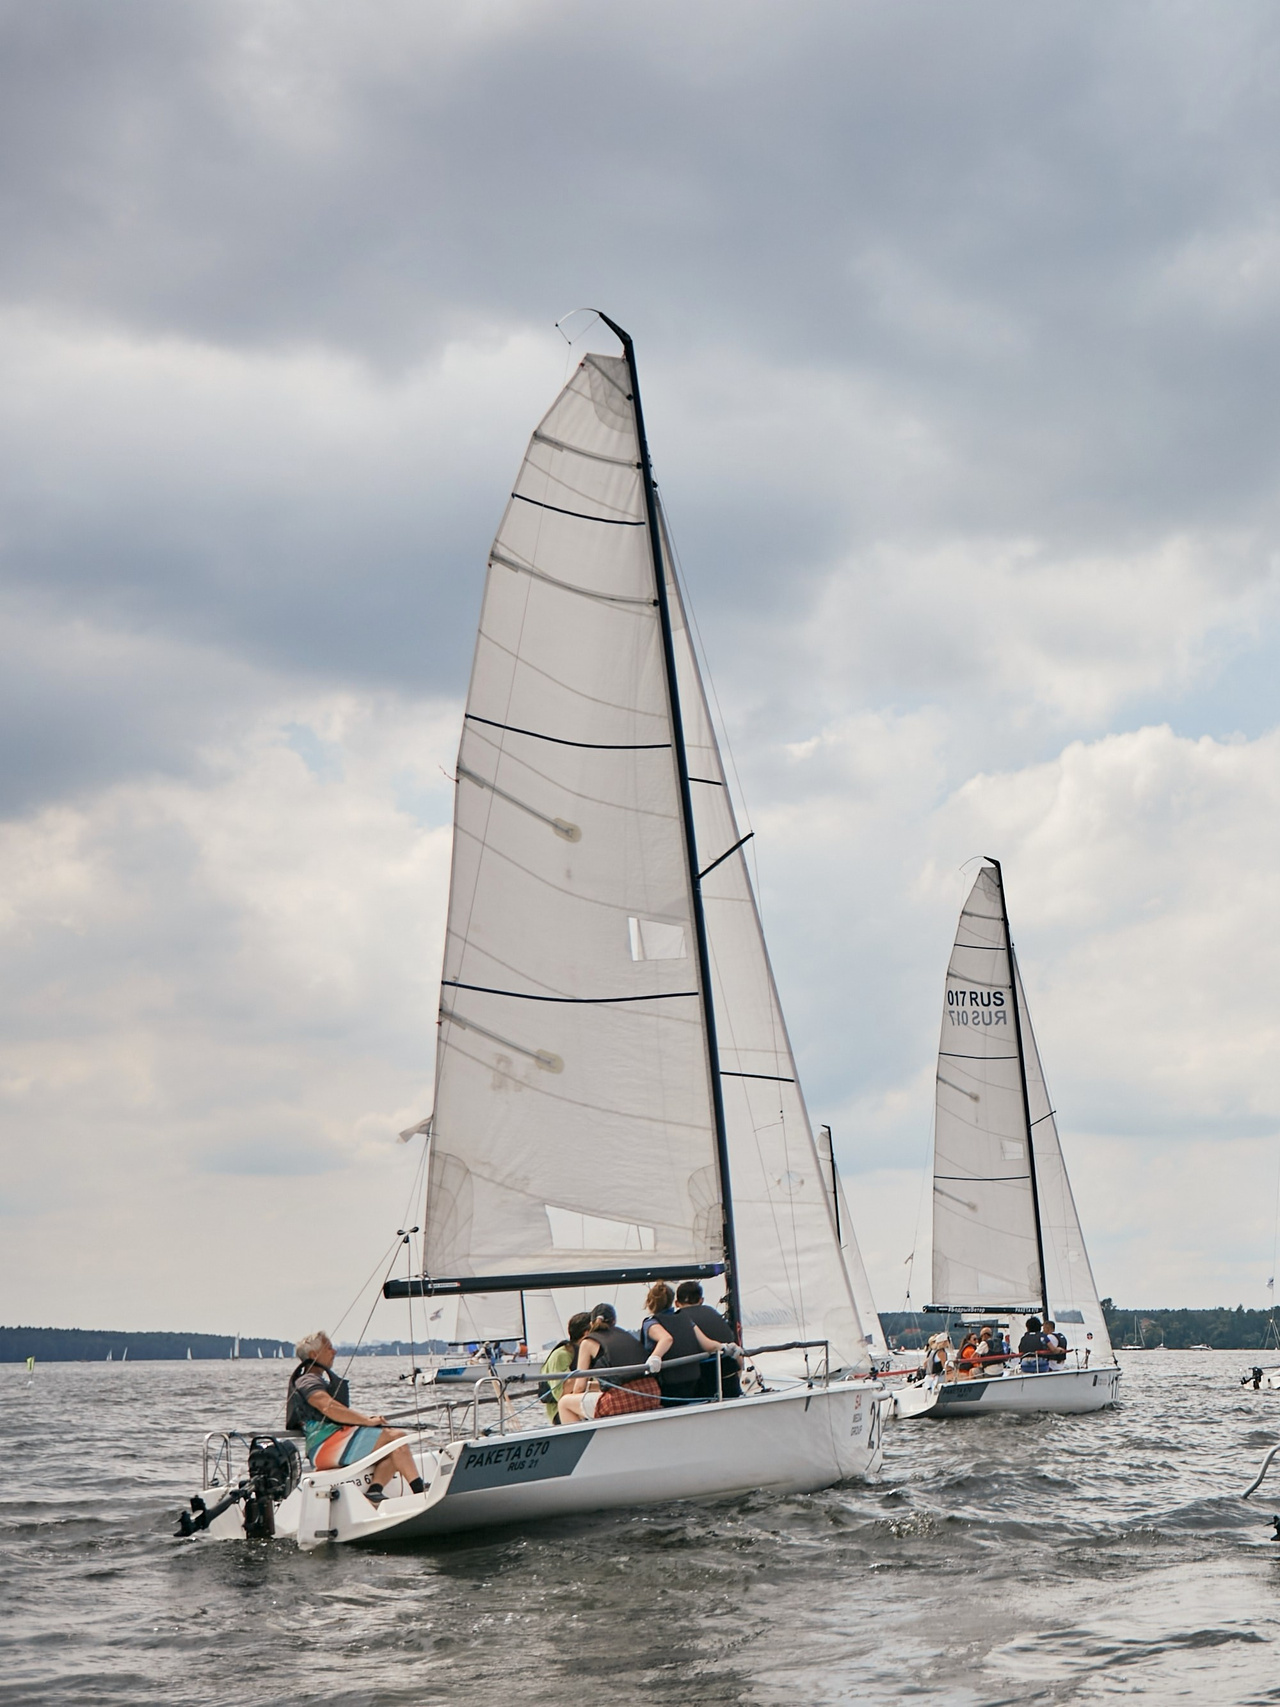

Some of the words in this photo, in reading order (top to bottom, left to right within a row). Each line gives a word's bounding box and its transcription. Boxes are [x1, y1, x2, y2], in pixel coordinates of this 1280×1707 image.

[947, 990, 967, 1007] 017
[969, 991, 1005, 1007] RUS
[464, 1448, 521, 1470] PAKETA
[525, 1441, 550, 1457] 670
[507, 1459, 526, 1472] RUS
[528, 1458, 540, 1469] 21
